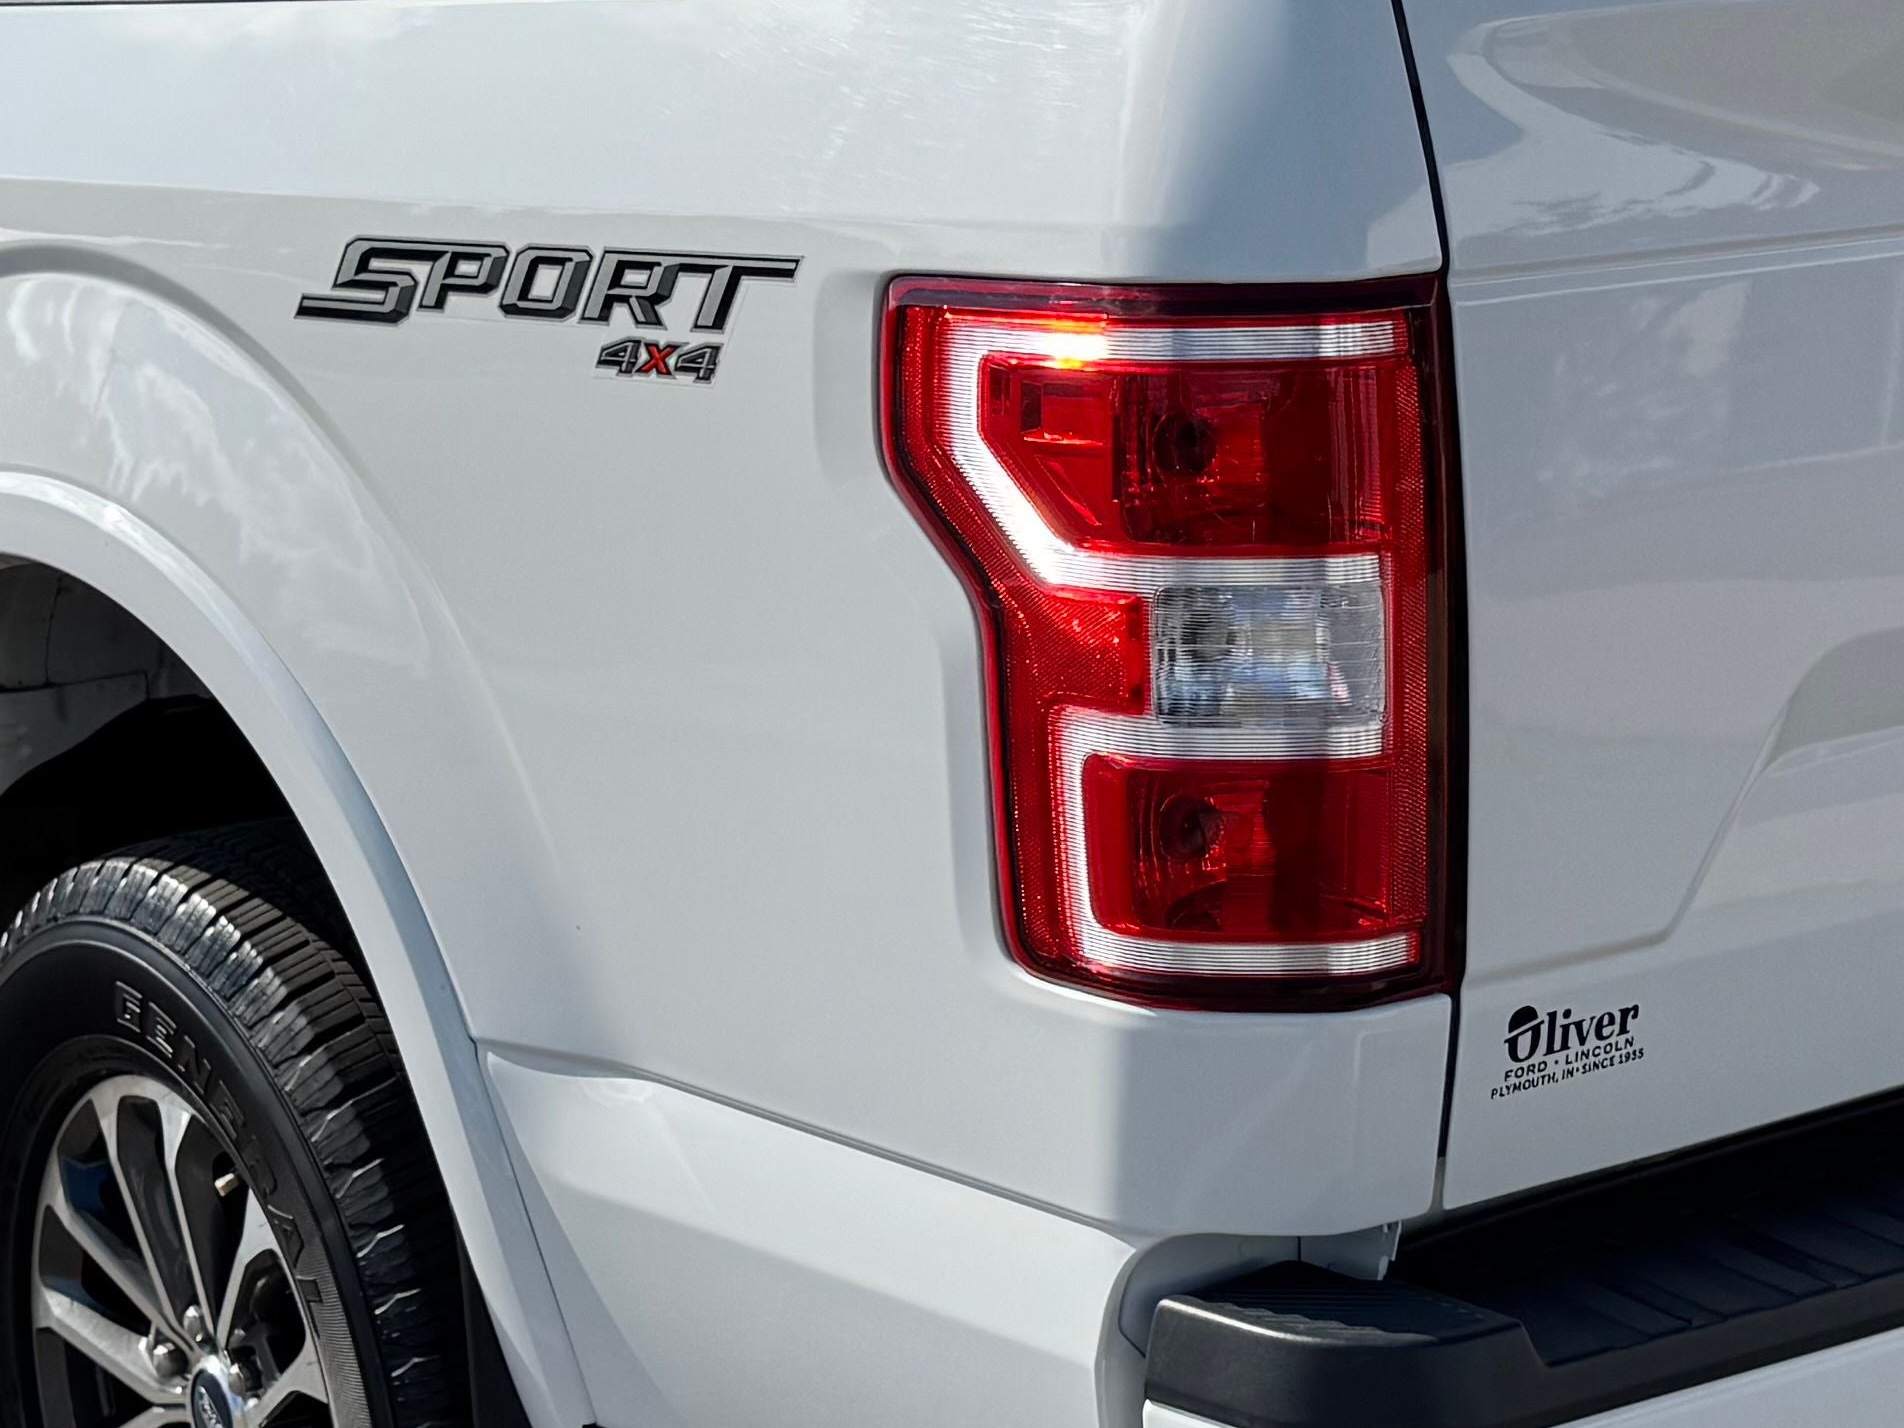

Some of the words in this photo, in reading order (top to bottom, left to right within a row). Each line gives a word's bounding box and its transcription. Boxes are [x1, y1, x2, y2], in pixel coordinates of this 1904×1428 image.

[293, 234, 804, 333] SPORT
[1504, 1003, 1639, 1063] Oliver
[1504, 1060, 1548, 1082] FORD
[1565, 1036, 1634, 1065] LINCOLN
[1490, 1071, 1559, 1100] PLYMOUTH,
[114, 979, 322, 1305] GENERAL
